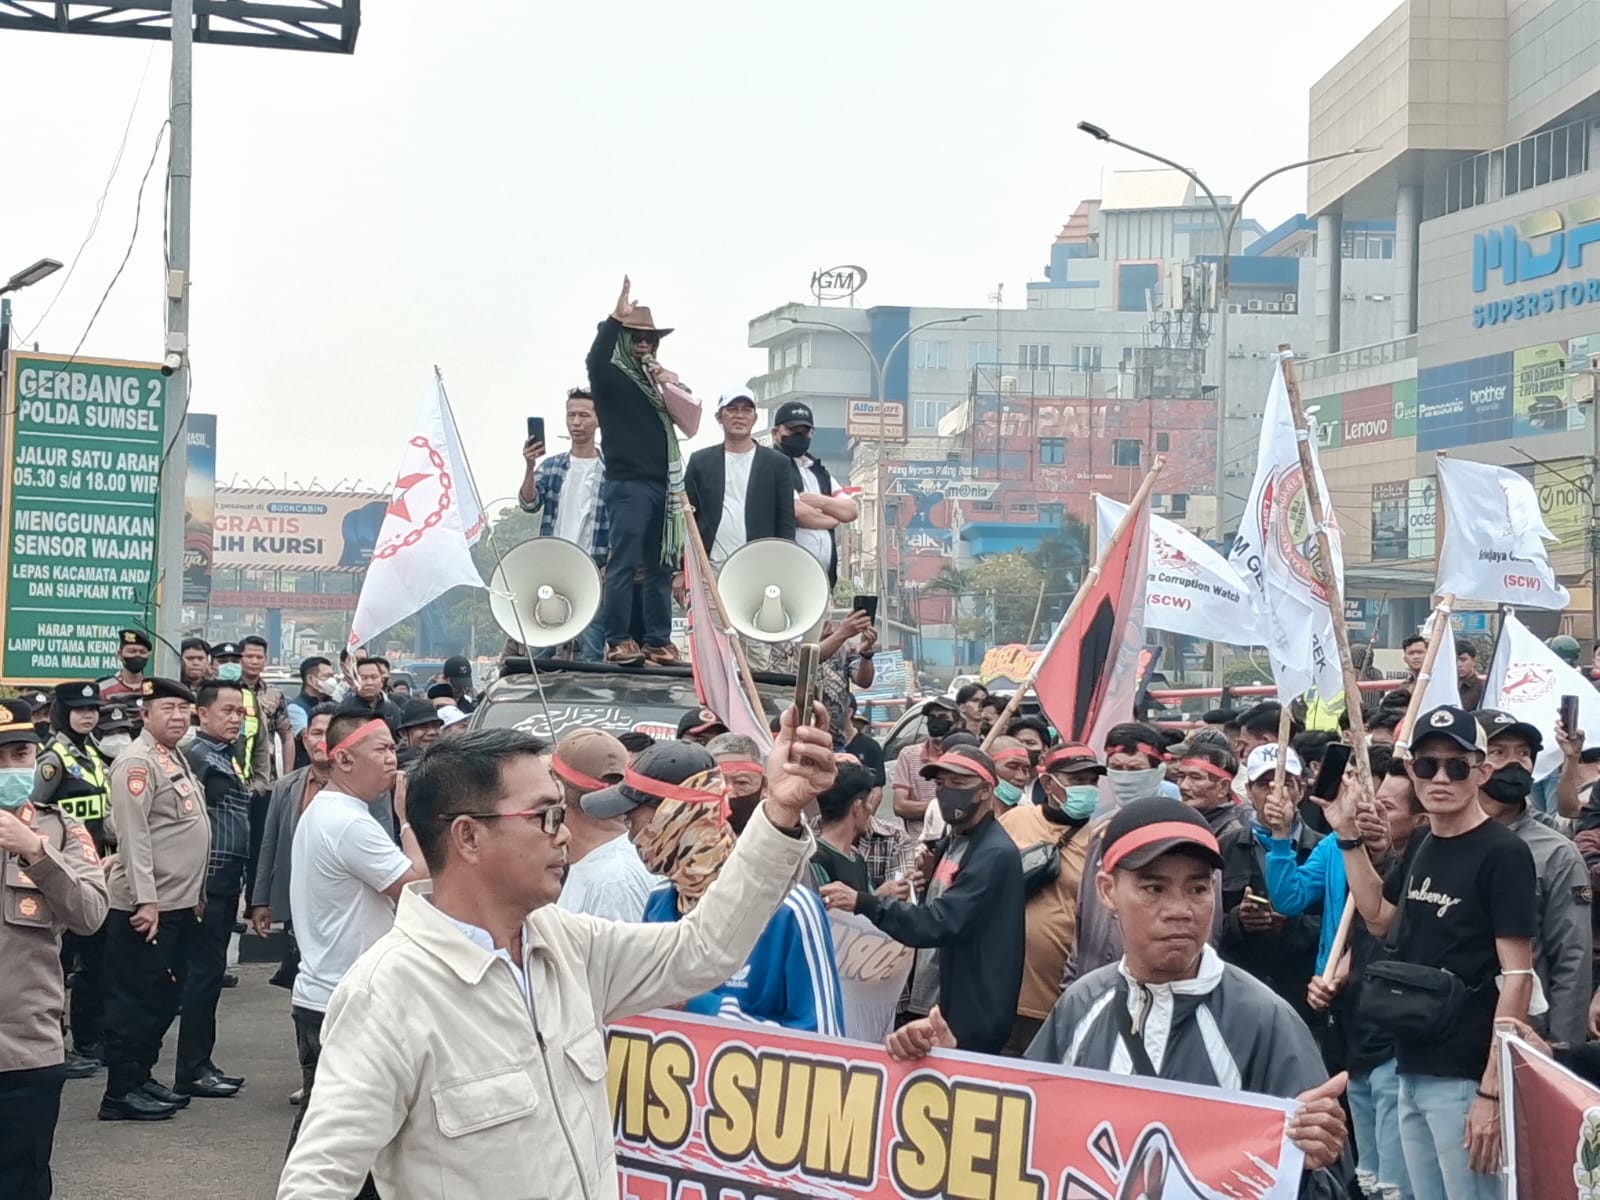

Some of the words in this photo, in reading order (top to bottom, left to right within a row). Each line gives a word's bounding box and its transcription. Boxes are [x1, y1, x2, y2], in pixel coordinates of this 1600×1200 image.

[19, 368, 140, 406] GERBANG
[147, 378, 162, 408] 2
[18, 400, 80, 426] POLDA
[85, 405, 159, 432] SUMSEL
[1345, 418, 1388, 440] Lenovo
[16, 446, 67, 467] JALUR
[71, 448, 112, 470] SATU
[116, 452, 160, 473] ARAH
[13, 466, 56, 487] 05.30
[59, 470, 82, 490] s/d
[86, 471, 127, 491] 18.00
[130, 474, 160, 494] WIB
[271, 503, 324, 513] BOOKCABIN
[15, 510, 155, 537] MENGGUNAKAN
[213, 515, 301, 534] GRATIS
[14, 534, 87, 558] SENSOR
[92, 537, 154, 561] WAJAH
[253, 536, 323, 554] KURSI
[12, 563, 50, 579] LEPAS
[53, 565, 118, 582] KACAMATA
[120, 568, 151, 584] ANDA
[1503, 574, 1541, 592] (SCW)
[28, 582, 53, 597] DAN
[56, 583, 110, 600] SIAPKAN
[111, 585, 135, 601] KTP
[1158, 572, 1210, 592] Corruption
[1212, 584, 1240, 603] Watch
[1146, 593, 1192, 612] (SCW)
[37, 623, 74, 638] HARAP
[8, 638, 45, 652] LAMPU
[48, 639, 84, 653] UTAMA
[31, 654, 59, 669] PADA
[62, 655, 99, 670] MALAM
[708, 1048, 882, 1182] SUM
[895, 1080, 1046, 1200] SEL
